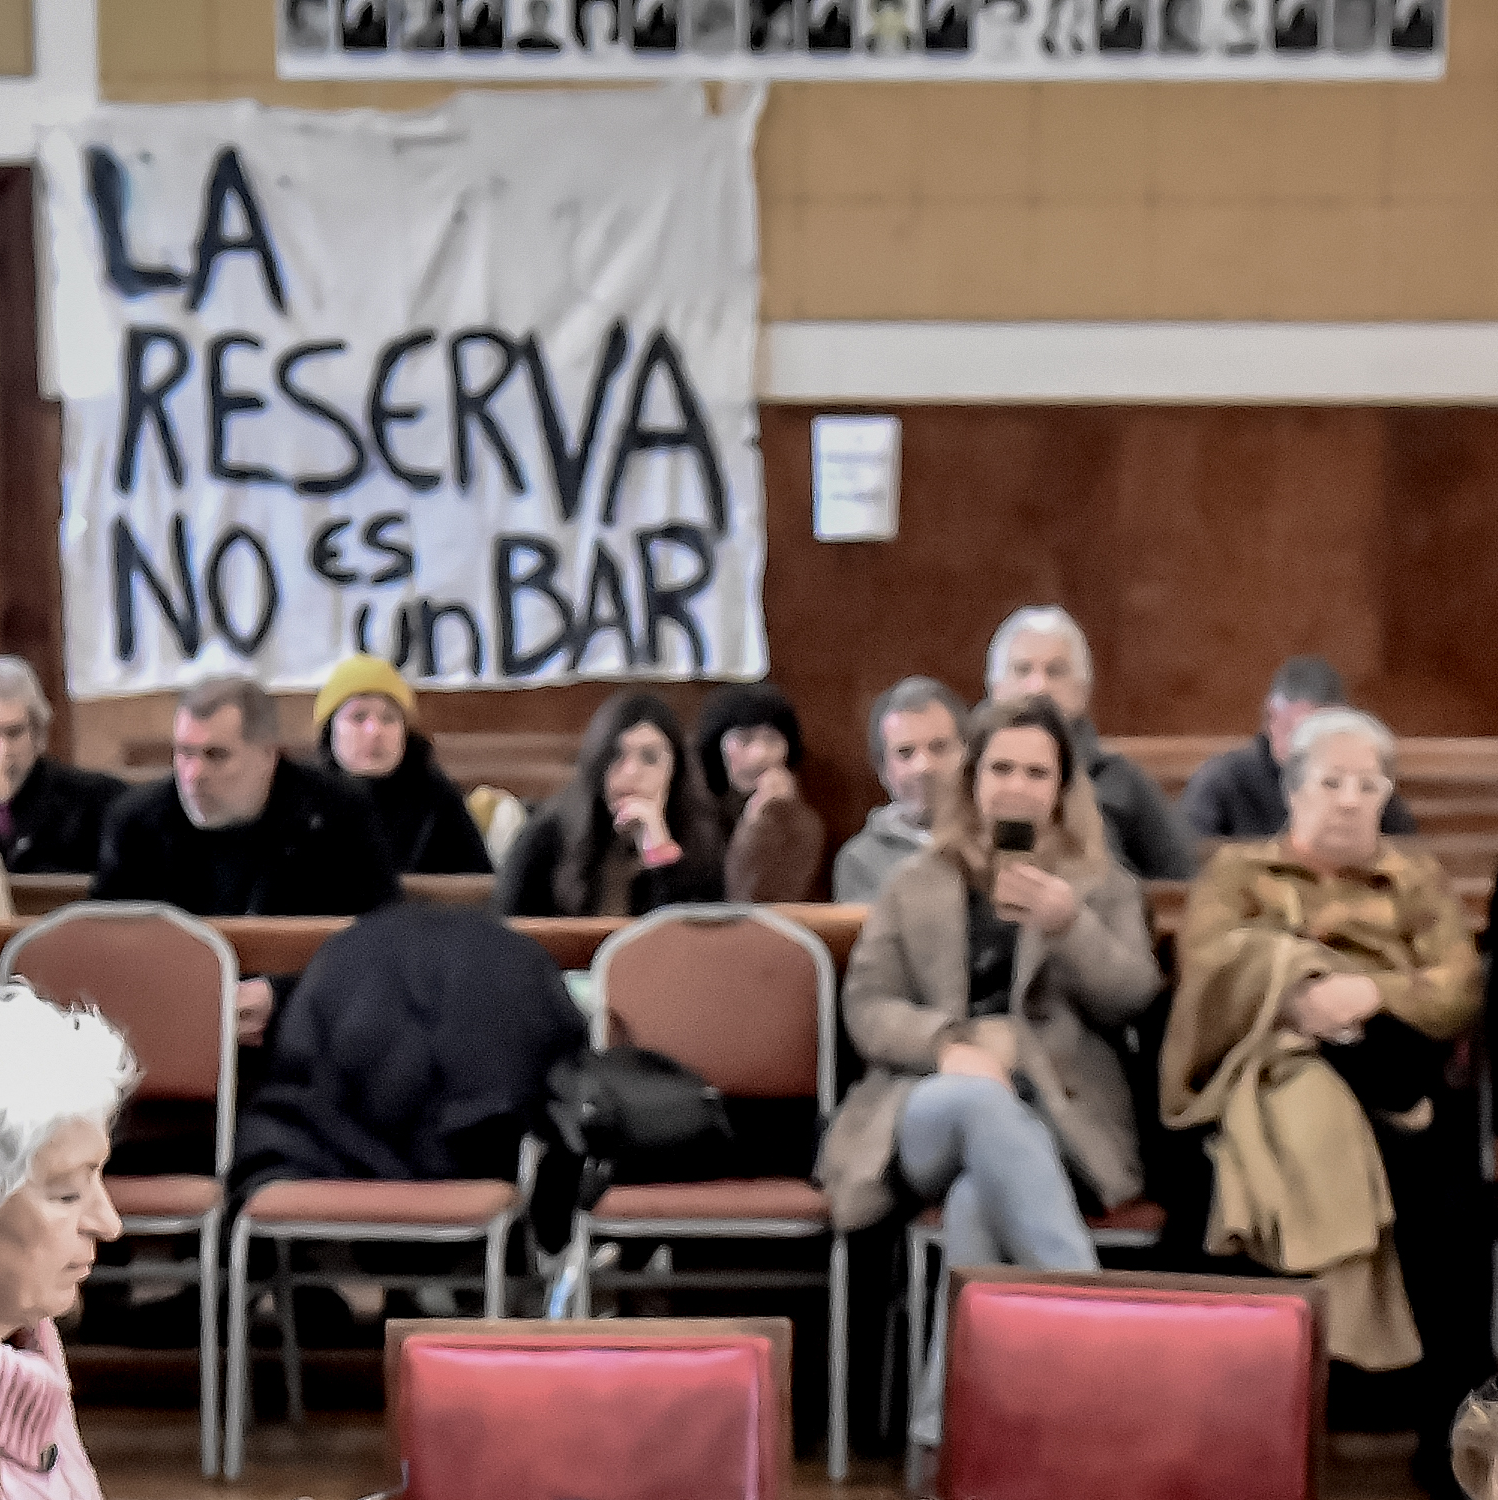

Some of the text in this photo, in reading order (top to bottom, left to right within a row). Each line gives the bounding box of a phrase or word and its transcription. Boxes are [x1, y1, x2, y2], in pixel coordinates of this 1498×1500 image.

[86, 145, 286, 313] LA
[116, 317, 729, 538] RESERVA
[112, 512, 280, 662] NO
[493, 521, 715, 679] BAR
